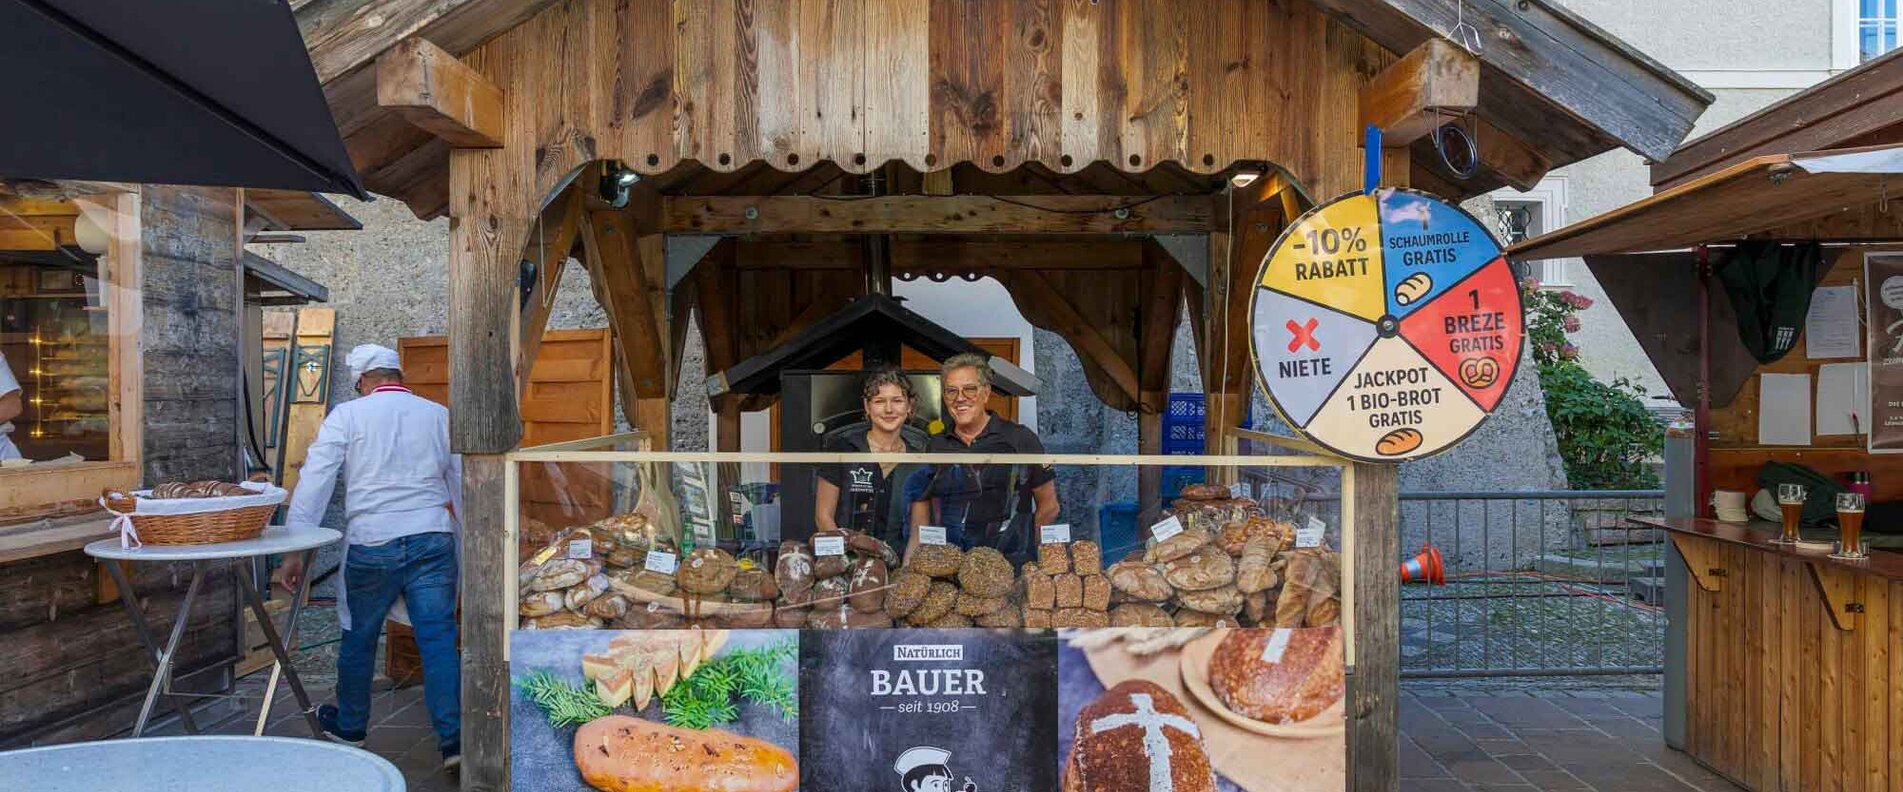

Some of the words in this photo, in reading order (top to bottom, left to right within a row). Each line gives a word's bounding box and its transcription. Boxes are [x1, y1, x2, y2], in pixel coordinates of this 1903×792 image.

[1293, 227, 1367, 256] -10%
[1389, 231, 1470, 250] SCHAUMROLLE
[1403, 248, 1456, 266] GRATIS
[1295, 258, 1369, 281] RABATT
[1469, 290, 1480, 310] 1
[1445, 312, 1506, 335] BREZE
[1450, 335, 1504, 354] GRATIS
[1279, 358, 1332, 378] NIETE
[1354, 367, 1429, 389] JACKPOT
[1347, 396, 1355, 411] 1
[1361, 388, 1442, 411] BIO-BROT
[1369, 410, 1423, 428] GRATIS
[870, 669, 987, 696] BAUER
[898, 700, 922, 713] seit
[926, 700, 959, 713] 1908
